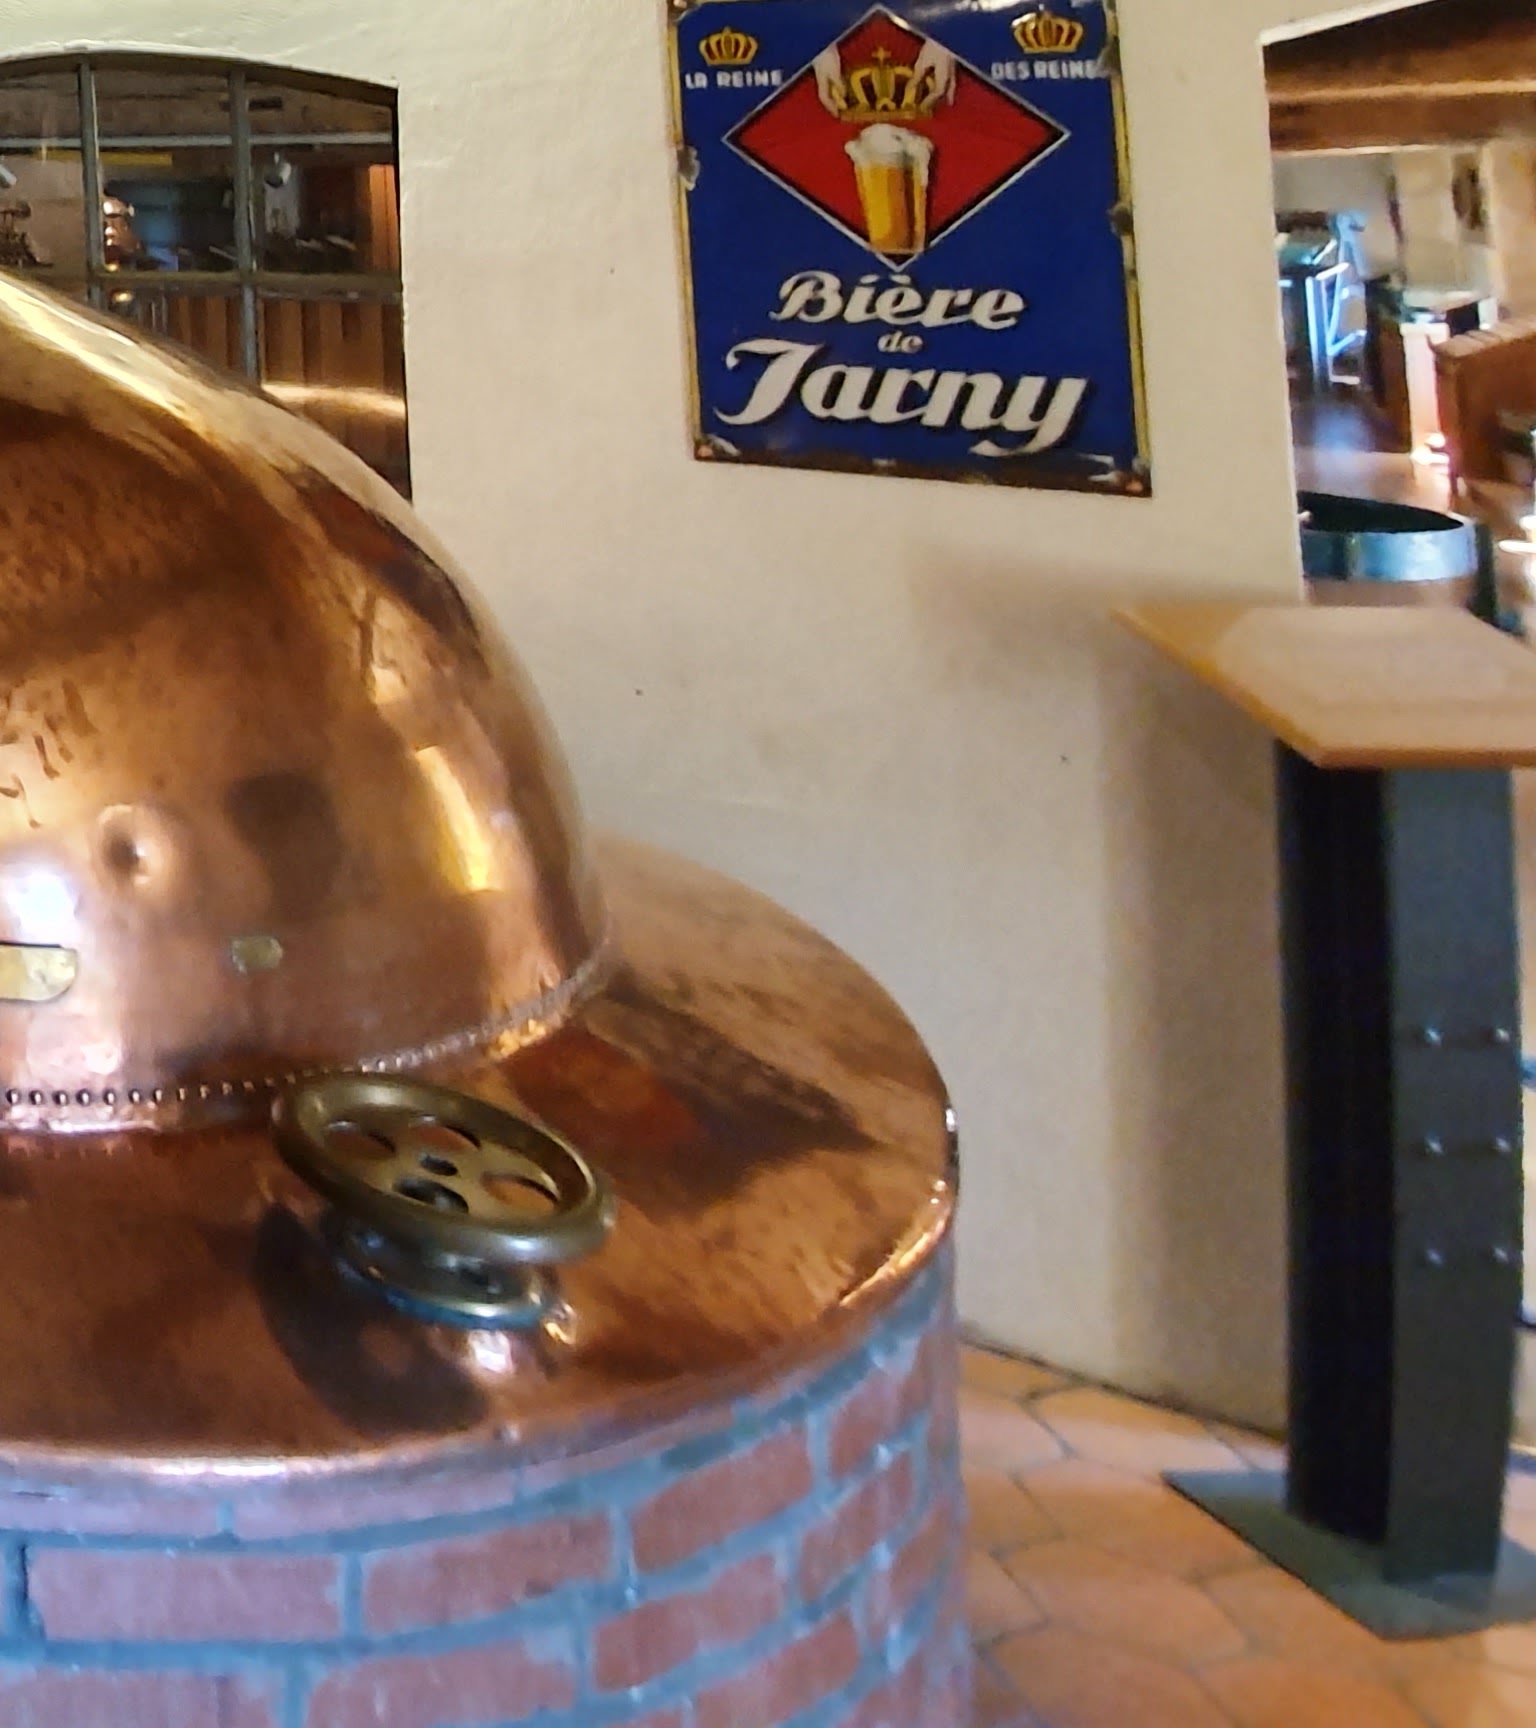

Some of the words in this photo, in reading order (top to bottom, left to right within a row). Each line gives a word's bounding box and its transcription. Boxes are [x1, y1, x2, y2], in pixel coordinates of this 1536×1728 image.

[685, 72, 708, 90] LA
[716, 69, 784, 88] REINE
[990, 60, 1031, 81] DES
[769, 269, 1027, 331] Bière
[877, 330, 924, 355] de
[712, 337, 1090, 458] Jarny
